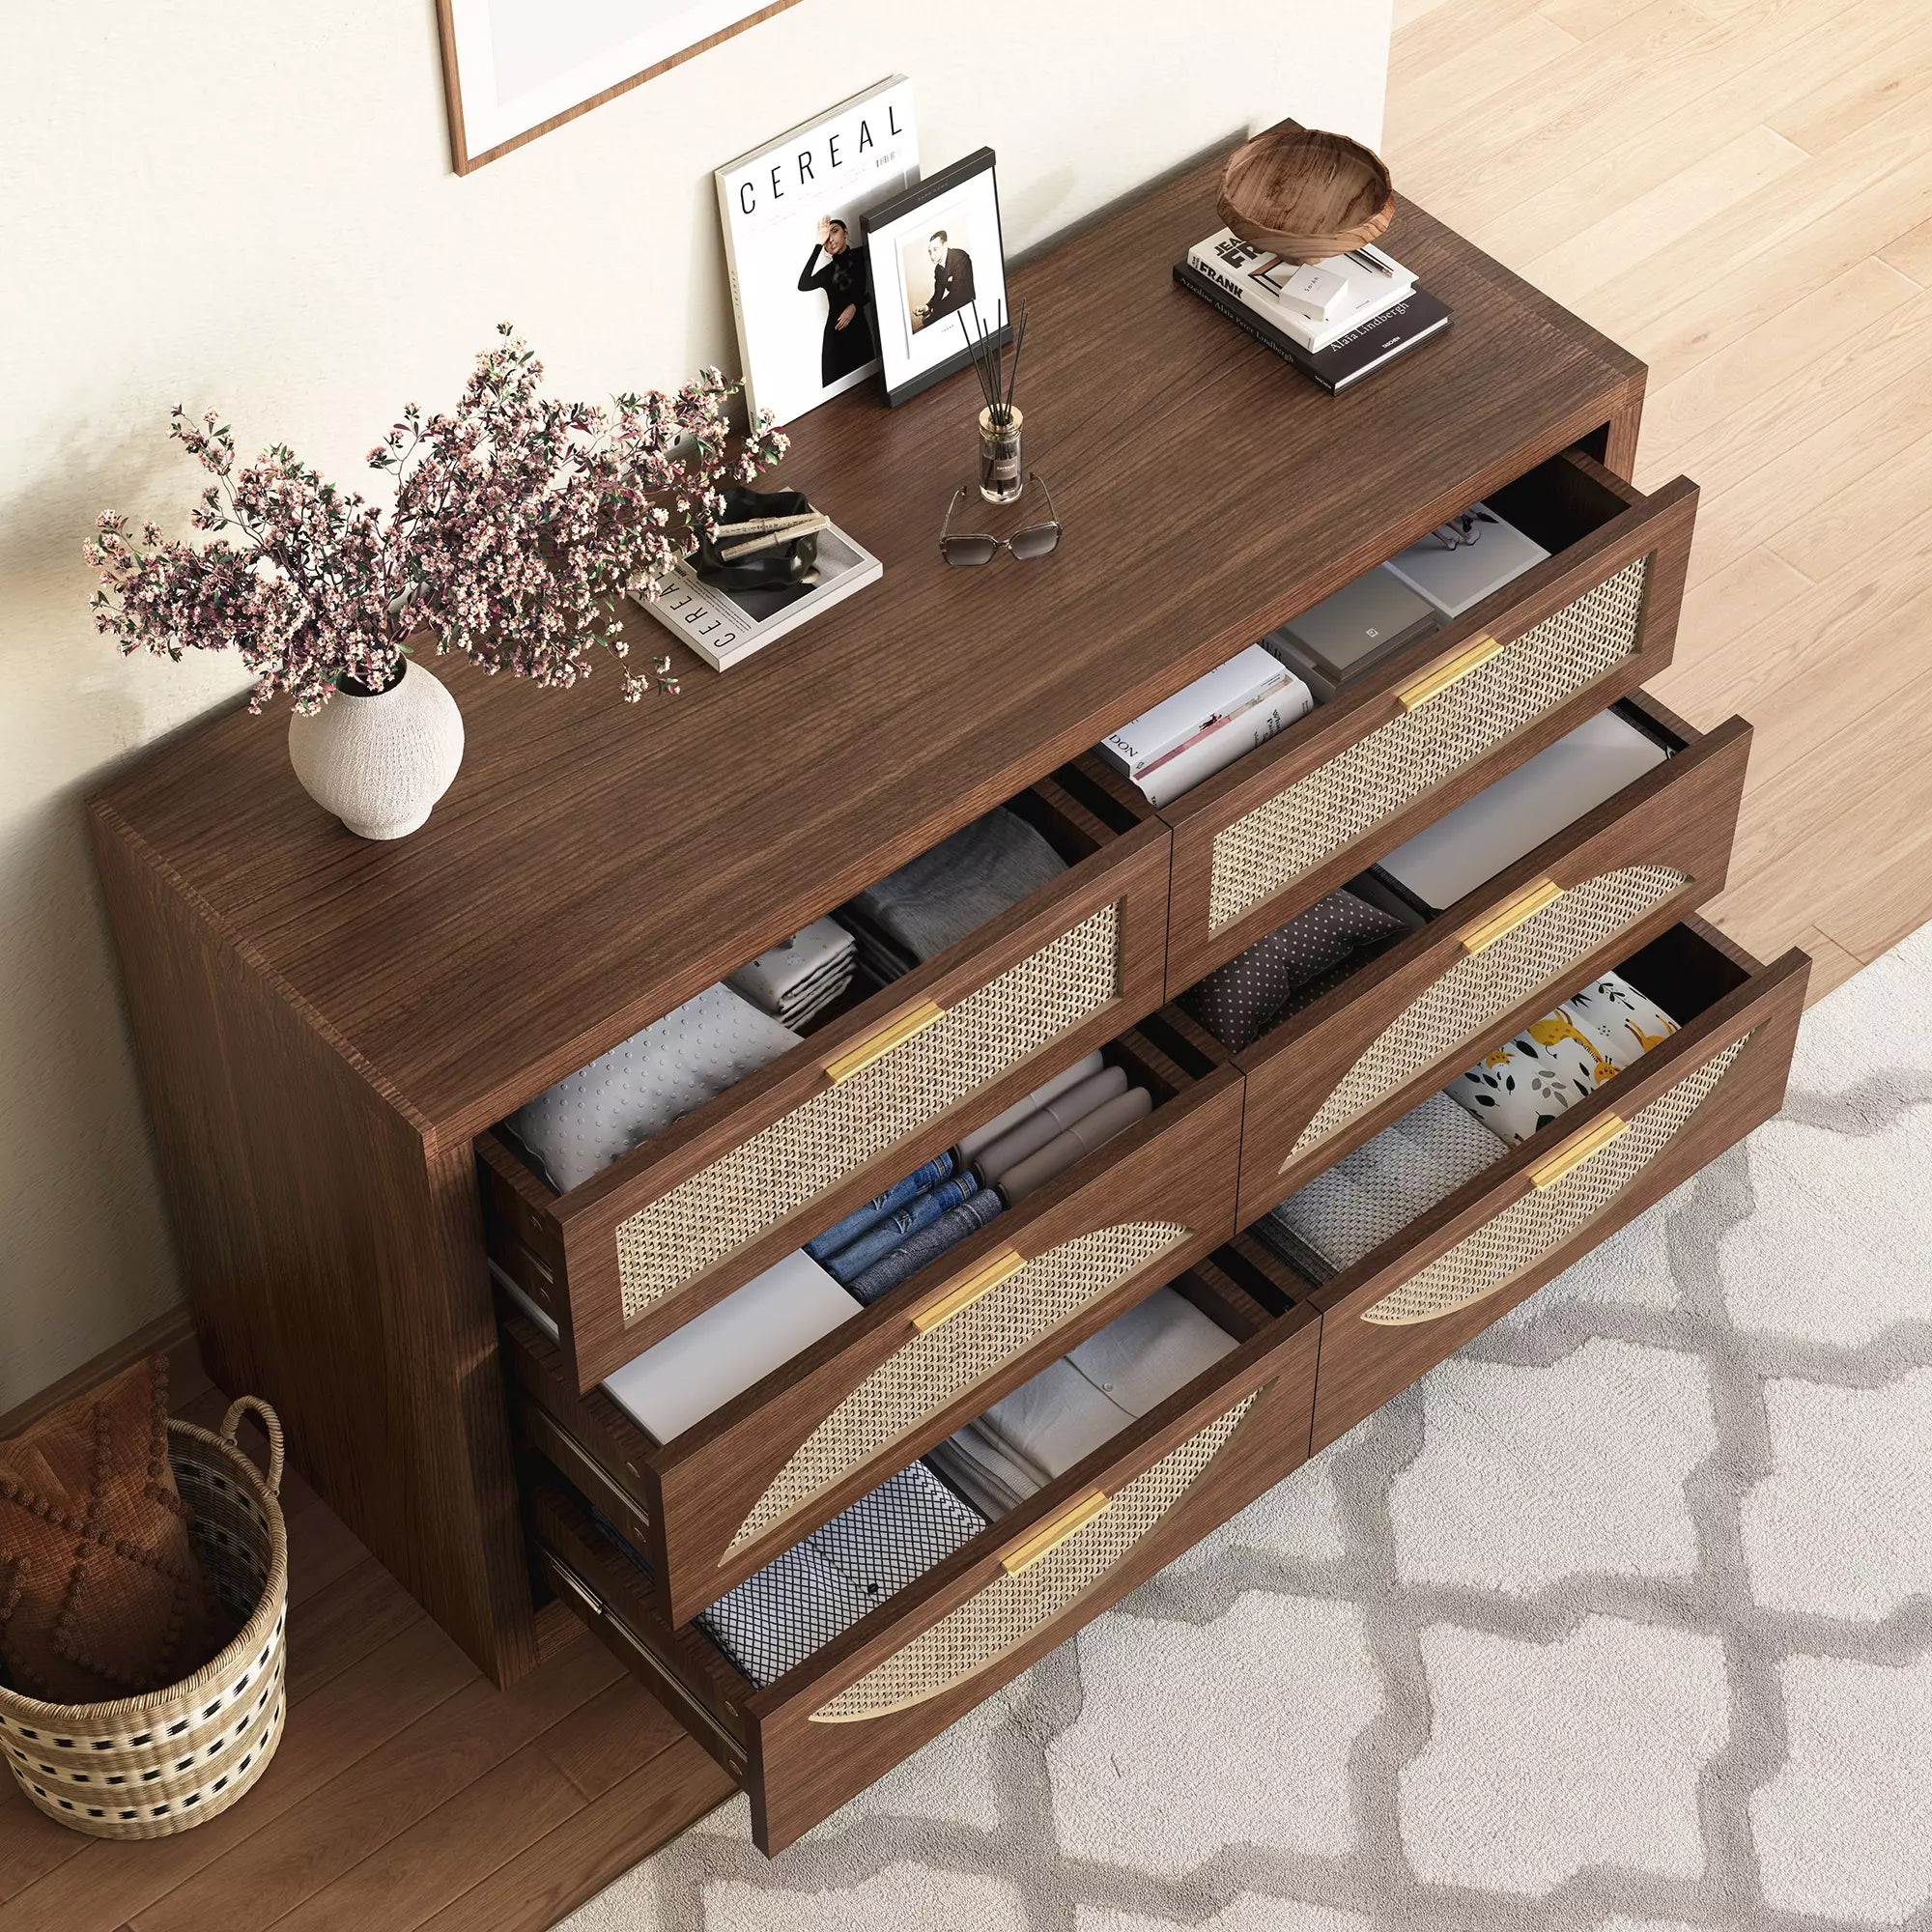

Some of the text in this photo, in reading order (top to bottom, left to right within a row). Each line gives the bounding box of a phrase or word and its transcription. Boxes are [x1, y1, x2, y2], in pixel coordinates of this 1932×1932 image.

[740, 106, 902, 214] CEREAL
[1214, 238, 1243, 256] JEA
[1221, 242, 1264, 270] FR
[1200, 261, 1244, 298] FRANK
[1356, 302, 1409, 335] Lindbergh
[1256, 331, 1293, 362] Lindbergh
[1381, 336, 1401, 349] TASCHEN
[1109, 734, 1138, 757] DON
